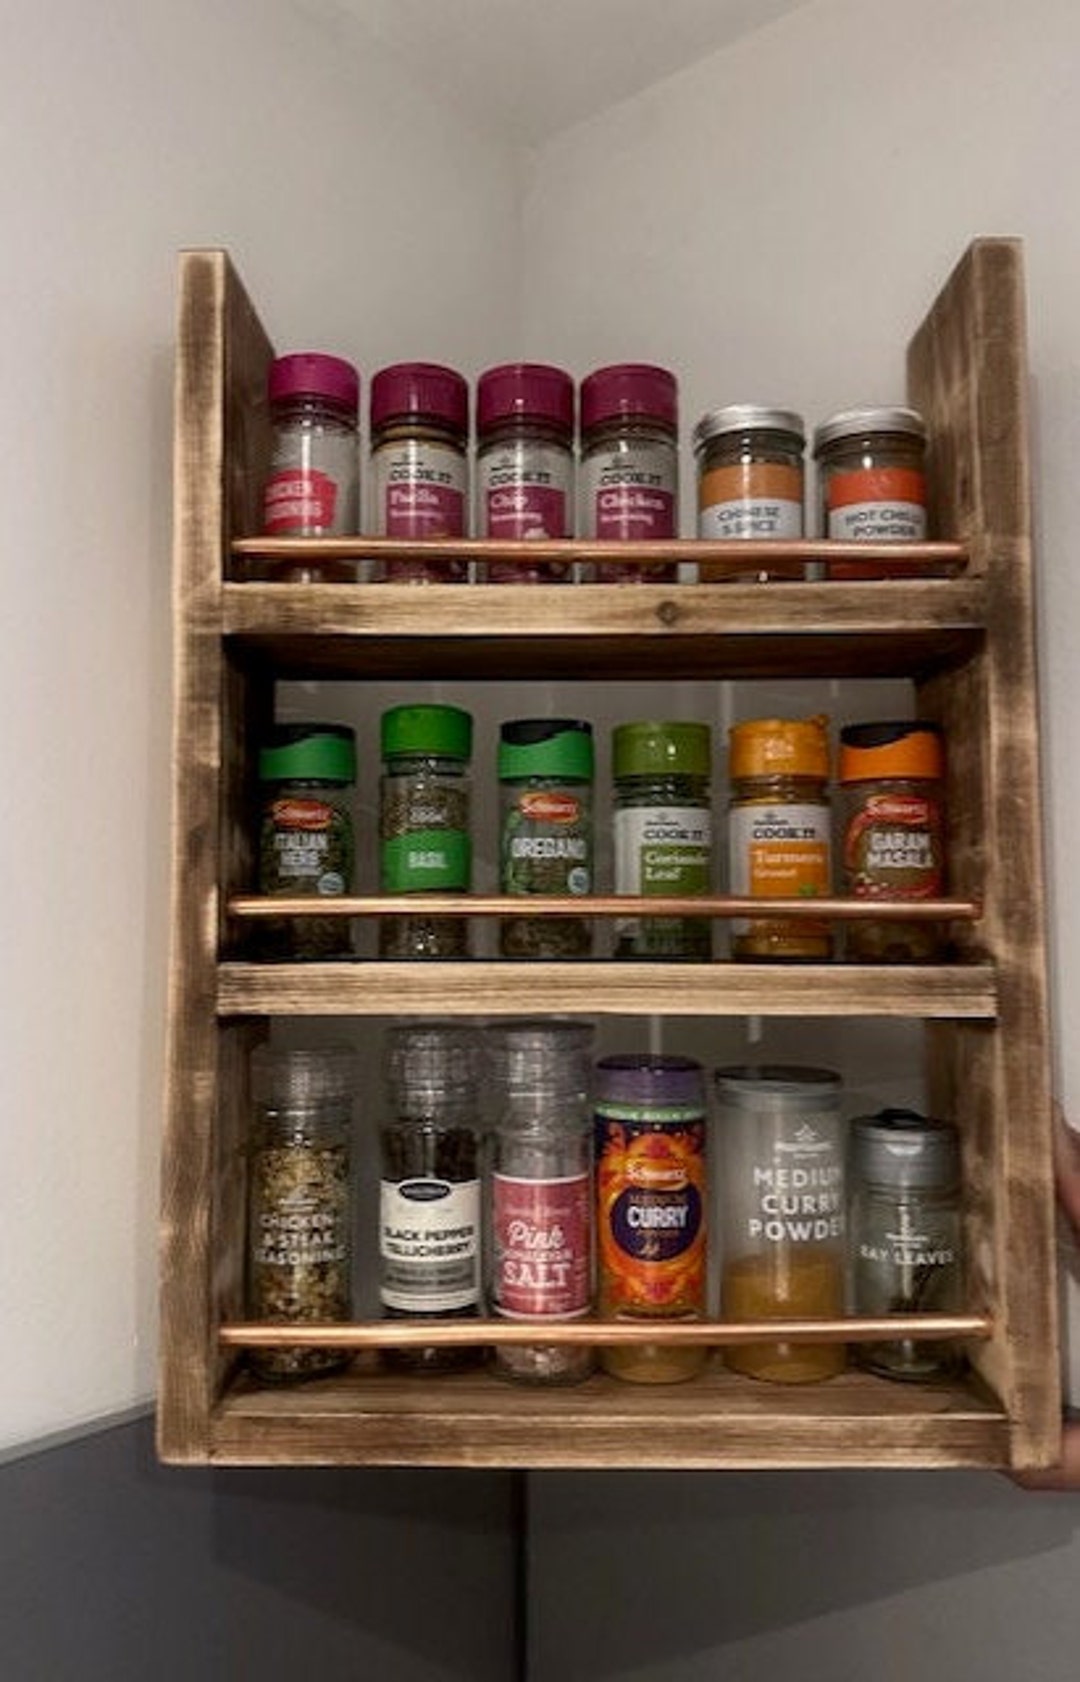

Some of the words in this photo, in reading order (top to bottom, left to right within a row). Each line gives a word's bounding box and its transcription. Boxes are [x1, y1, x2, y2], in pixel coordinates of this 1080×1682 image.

[511, 837, 586, 858] OREGANO
[626, 1205, 689, 1229] CURRY
[507, 1219, 566, 1250] Pink
[503, 1261, 572, 1289] SALT
